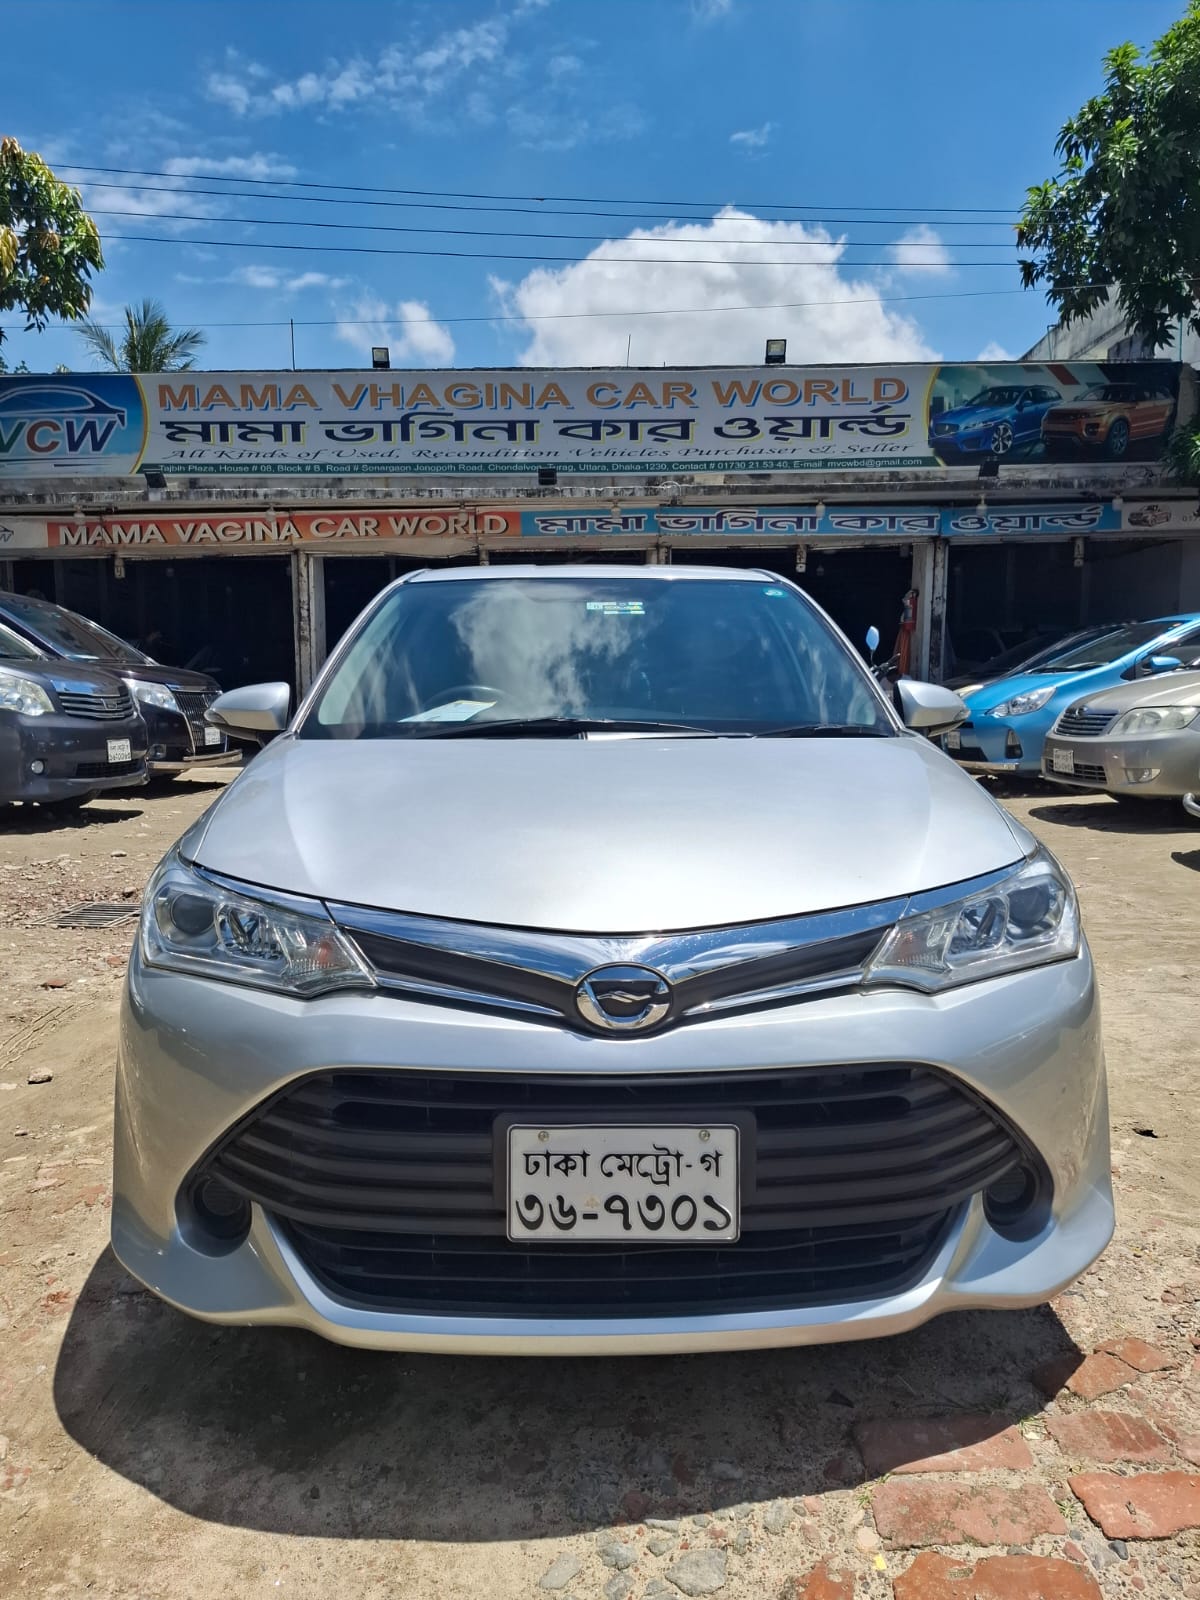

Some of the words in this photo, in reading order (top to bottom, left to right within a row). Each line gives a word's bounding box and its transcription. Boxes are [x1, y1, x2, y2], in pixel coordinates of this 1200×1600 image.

[158, 383, 321, 411] MAMA
[331, 382, 574, 410] VHAGINA
[586, 380, 698, 408] CAR
[711, 377, 909, 406] WORLD
[160, 420, 306, 443] মামা
[319, 411, 540, 443] ভাগিনা
[553, 417, 696, 442] কার
[162, 448, 211, 460] All
[213, 448, 290, 460] Kinds
[297, 448, 328, 460] of
[332, 447, 401, 459] Used,
[411, 447, 560, 459] Recondition
[569, 446, 672, 458] Vehicles
[677, 443, 803, 457] Purchaser
[840, 441, 914, 455] Seller
[220, 464, 250, 472] House
[252, 464, 258, 472] #
[277, 464, 304, 472] Block
[305, 464, 311, 472] #
[326, 463, 351, 472] Road
[353, 464, 359, 472] #
[672, 462, 707, 471] Contact
[709, 462, 716, 470] #
[717, 461, 746, 470] 01730
[749, 461, 760, 469] 21
[59, 525, 168, 547] MAMA
[173, 518, 302, 544] VAGINA
[310, 516, 380, 538] CAR
[387, 514, 510, 537] WORLD
[535, 515, 648, 534] মামা
[656, 509, 818, 533] ভাগিনা
[829, 512, 940, 532] কার
[522, 1149, 591, 1178] ঢাকা
[515, 1194, 733, 1232] ৩৬-৭৩০১
